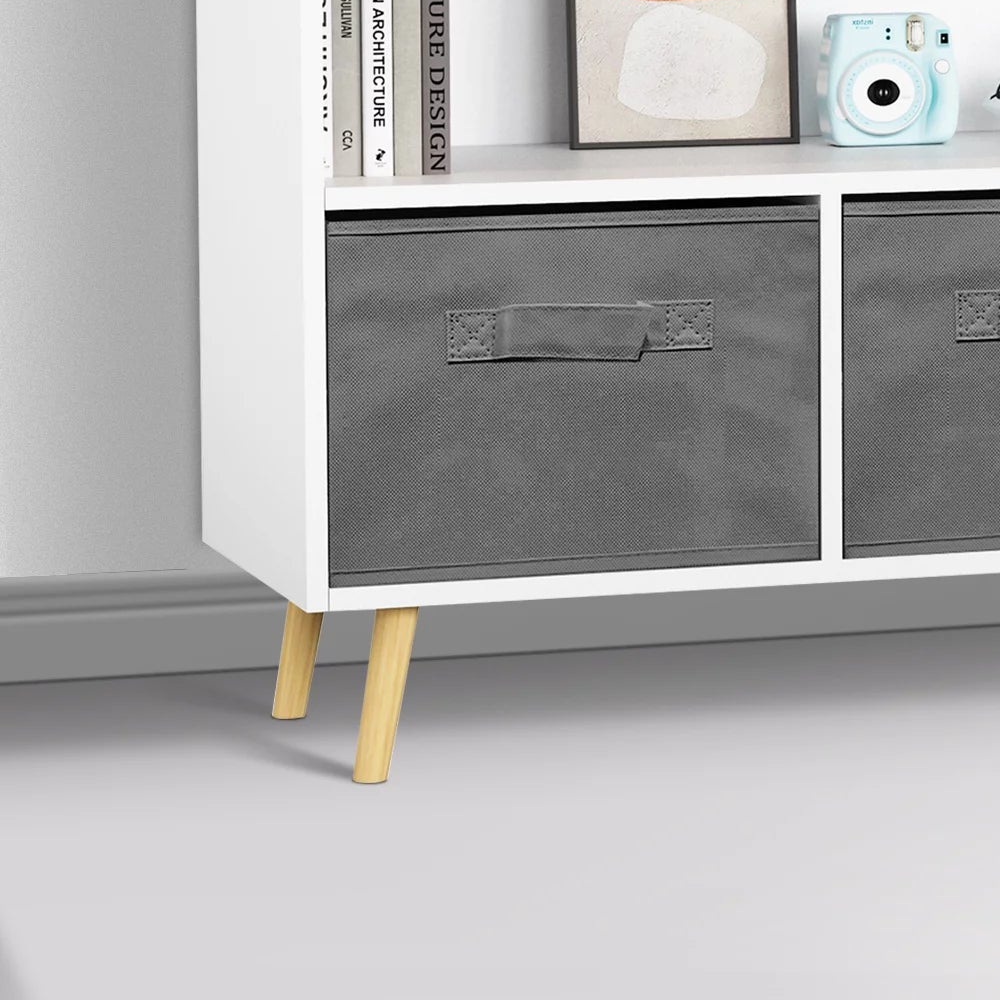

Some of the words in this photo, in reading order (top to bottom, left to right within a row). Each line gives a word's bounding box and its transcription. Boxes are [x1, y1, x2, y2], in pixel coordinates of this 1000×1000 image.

[372, 8, 386, 128] ARCHITECTURE
[429, 67, 446, 172] DESIGN
[342, 129, 353, 151] CCA
